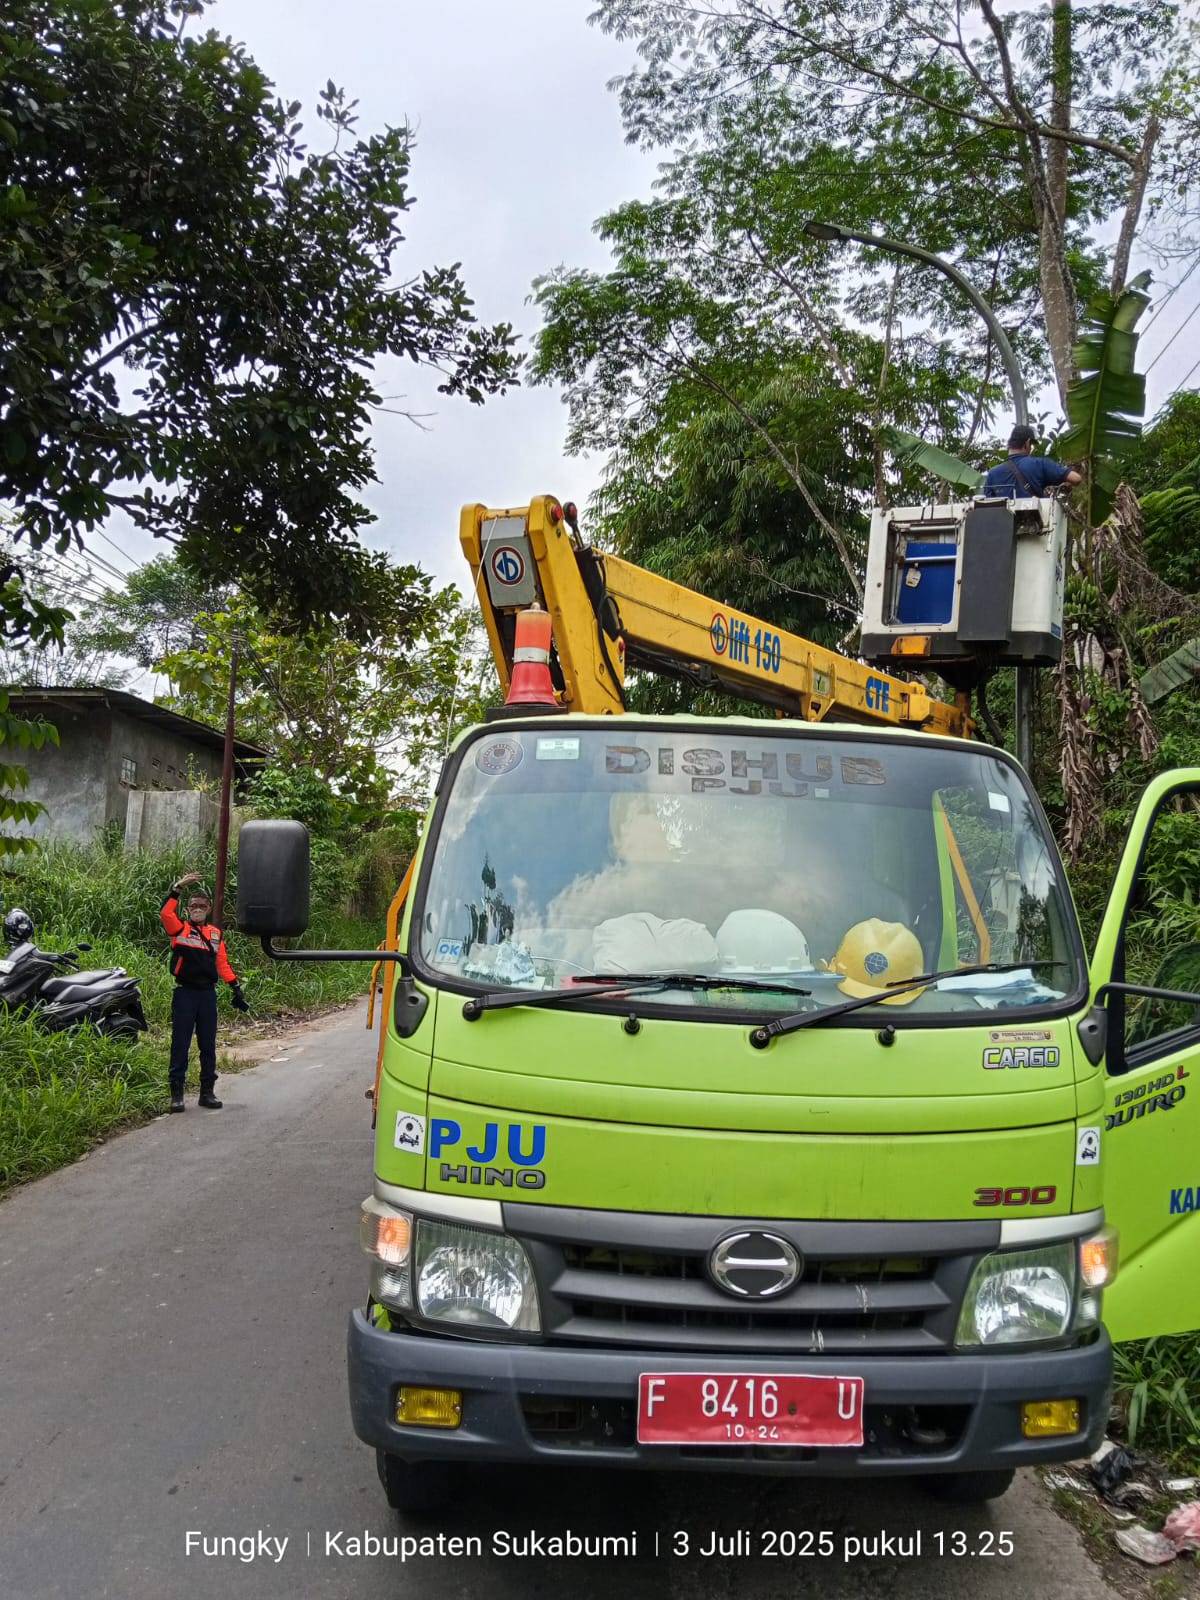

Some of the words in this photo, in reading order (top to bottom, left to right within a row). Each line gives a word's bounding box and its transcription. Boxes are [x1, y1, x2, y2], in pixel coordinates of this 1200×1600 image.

[729, 617, 750, 665] lift
[754, 628, 781, 674] 150
[865, 675, 890, 714] CTE
[605, 745, 887, 786] DISHUB
[691, 776, 809, 798] PJU
[439, 944, 460, 956] OK
[983, 1047, 1060, 1069] CARGO
[1114, 1084, 1147, 1108] 130
[430, 1118, 546, 1167] PJU
[440, 1163, 546, 1190] HINO
[973, 1185, 1057, 1206] 300
[647, 1379, 666, 1417] F
[701, 1379, 778, 1418] 8416
[838, 1383, 856, 1420] U
